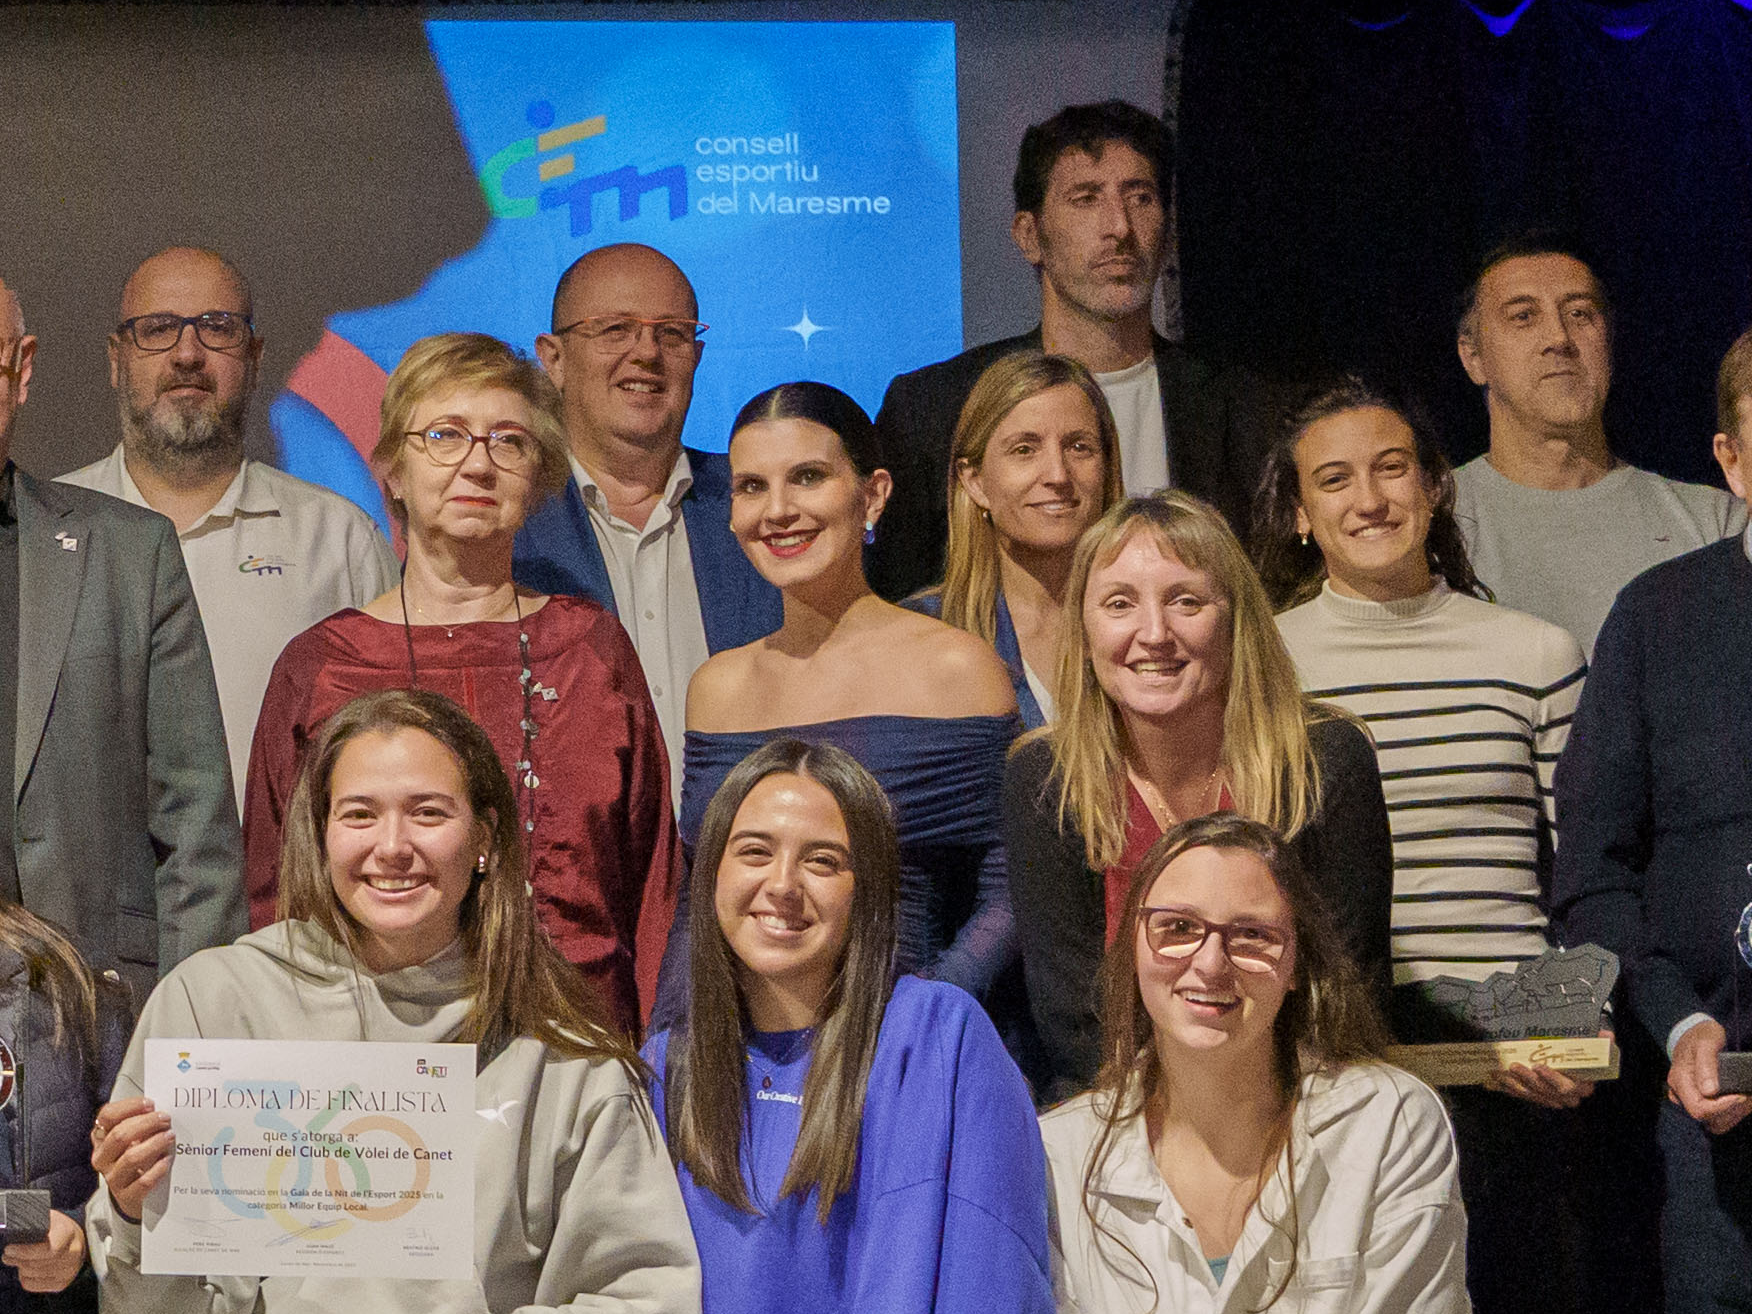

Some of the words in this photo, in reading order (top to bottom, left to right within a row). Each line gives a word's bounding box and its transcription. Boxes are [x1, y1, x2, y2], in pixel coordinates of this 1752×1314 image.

[696, 132, 798, 155] consell
[696, 160, 819, 189] esportiu
[697, 192, 738, 215] del
[750, 193, 892, 215] Maresme
[174, 1087, 281, 1110] DIPLOMA
[289, 1088, 321, 1111] DE
[327, 1089, 447, 1113] FINALISTA
[263, 1131, 288, 1143] que
[292, 1129, 343, 1145] s'atorga
[347, 1132, 359, 1143] a:
[176, 1142, 219, 1156] Sènior
[223, 1144, 272, 1157] Femení
[275, 1145, 296, 1157] del
[299, 1145, 330, 1158] Club
[334, 1146, 351, 1159] de
[355, 1146, 389, 1160] Vòlei
[393, 1147, 409, 1160] de
[413, 1147, 453, 1161] Canet
[174, 1186, 188, 1195] Per
[190, 1186, 198, 1195] la
[200, 1188, 220, 1196] seva
[267, 1189, 279, 1197] en
[281, 1188, 289, 1197] la
[312, 1188, 323, 1198] de
[325, 1188, 333, 1197] la
[334, 1189, 348, 1198] Nit
[350, 1189, 362, 1198] de
[363, 1189, 397, 1199] l'Esport
[399, 1190, 421, 1199] 2025
[422, 1191, 434, 1199] en
[436, 1191, 444, 1200] la
[247, 1202, 287, 1211] categoria
[289, 1201, 315, 1210] Millor
[317, 1202, 342, 1212] Equip
